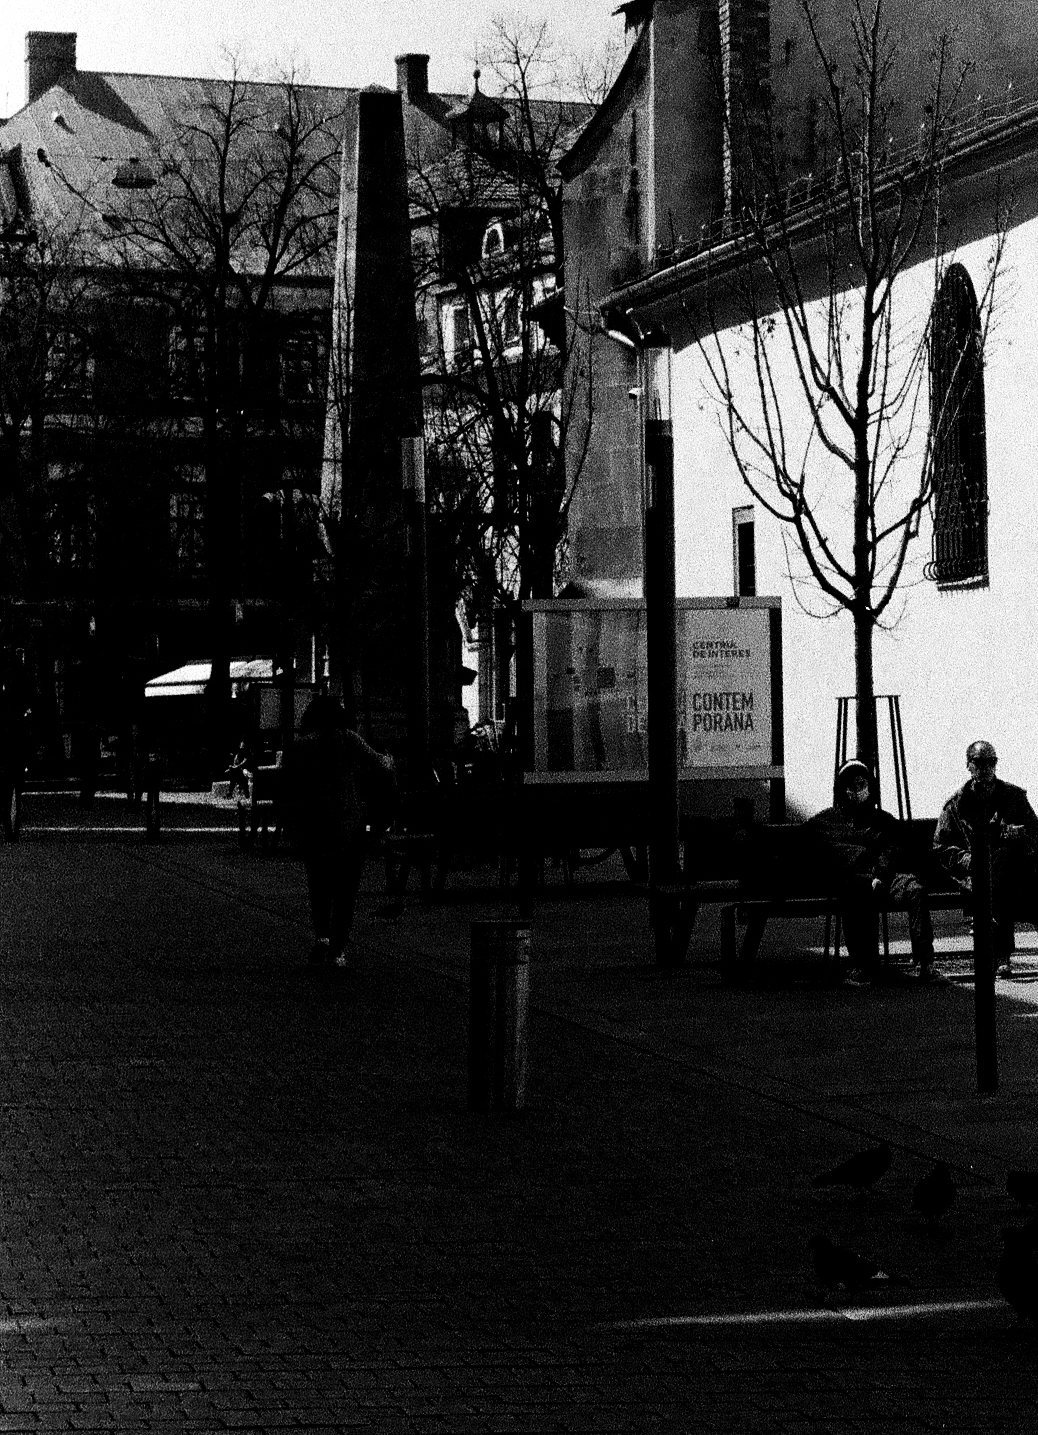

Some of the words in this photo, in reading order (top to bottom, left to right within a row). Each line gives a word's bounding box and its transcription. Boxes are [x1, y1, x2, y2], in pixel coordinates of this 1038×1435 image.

[708, 650, 751, 658] INTERES
[692, 691, 754, 711] CONTEM
[693, 712, 754, 732] PORANA
